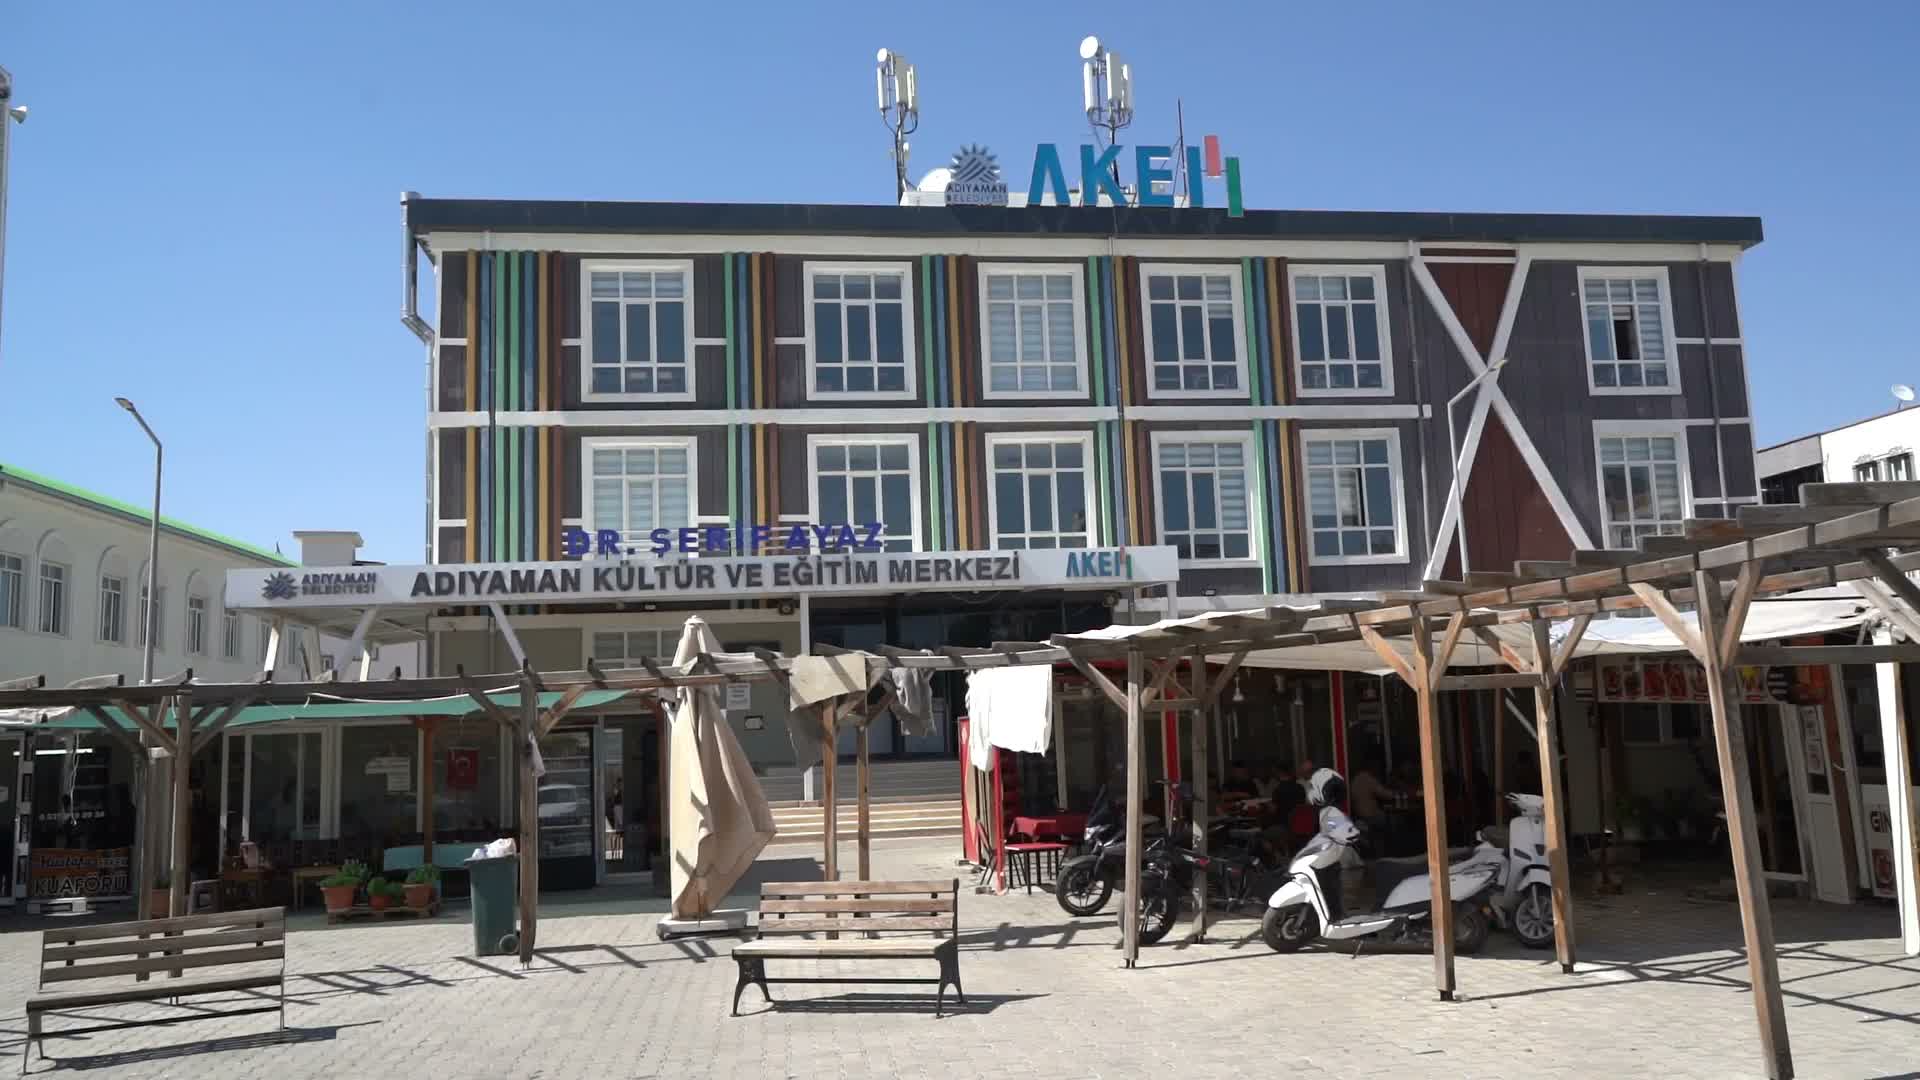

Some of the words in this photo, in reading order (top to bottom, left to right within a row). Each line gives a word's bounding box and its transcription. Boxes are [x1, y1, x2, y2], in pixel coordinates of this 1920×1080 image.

[566, 528, 636, 555] DR.
[784, 523, 884, 550] AYAZ
[301, 572, 377, 586] ADIYAMAN
[411, 567, 581, 597] ADIYAMAN
[593, 560, 717, 592] KÜLTÜR
[724, 564, 763, 588] VE
[773, 555, 878, 586] EĞİTİM
[889, 552, 1020, 584] MERKEZİ
